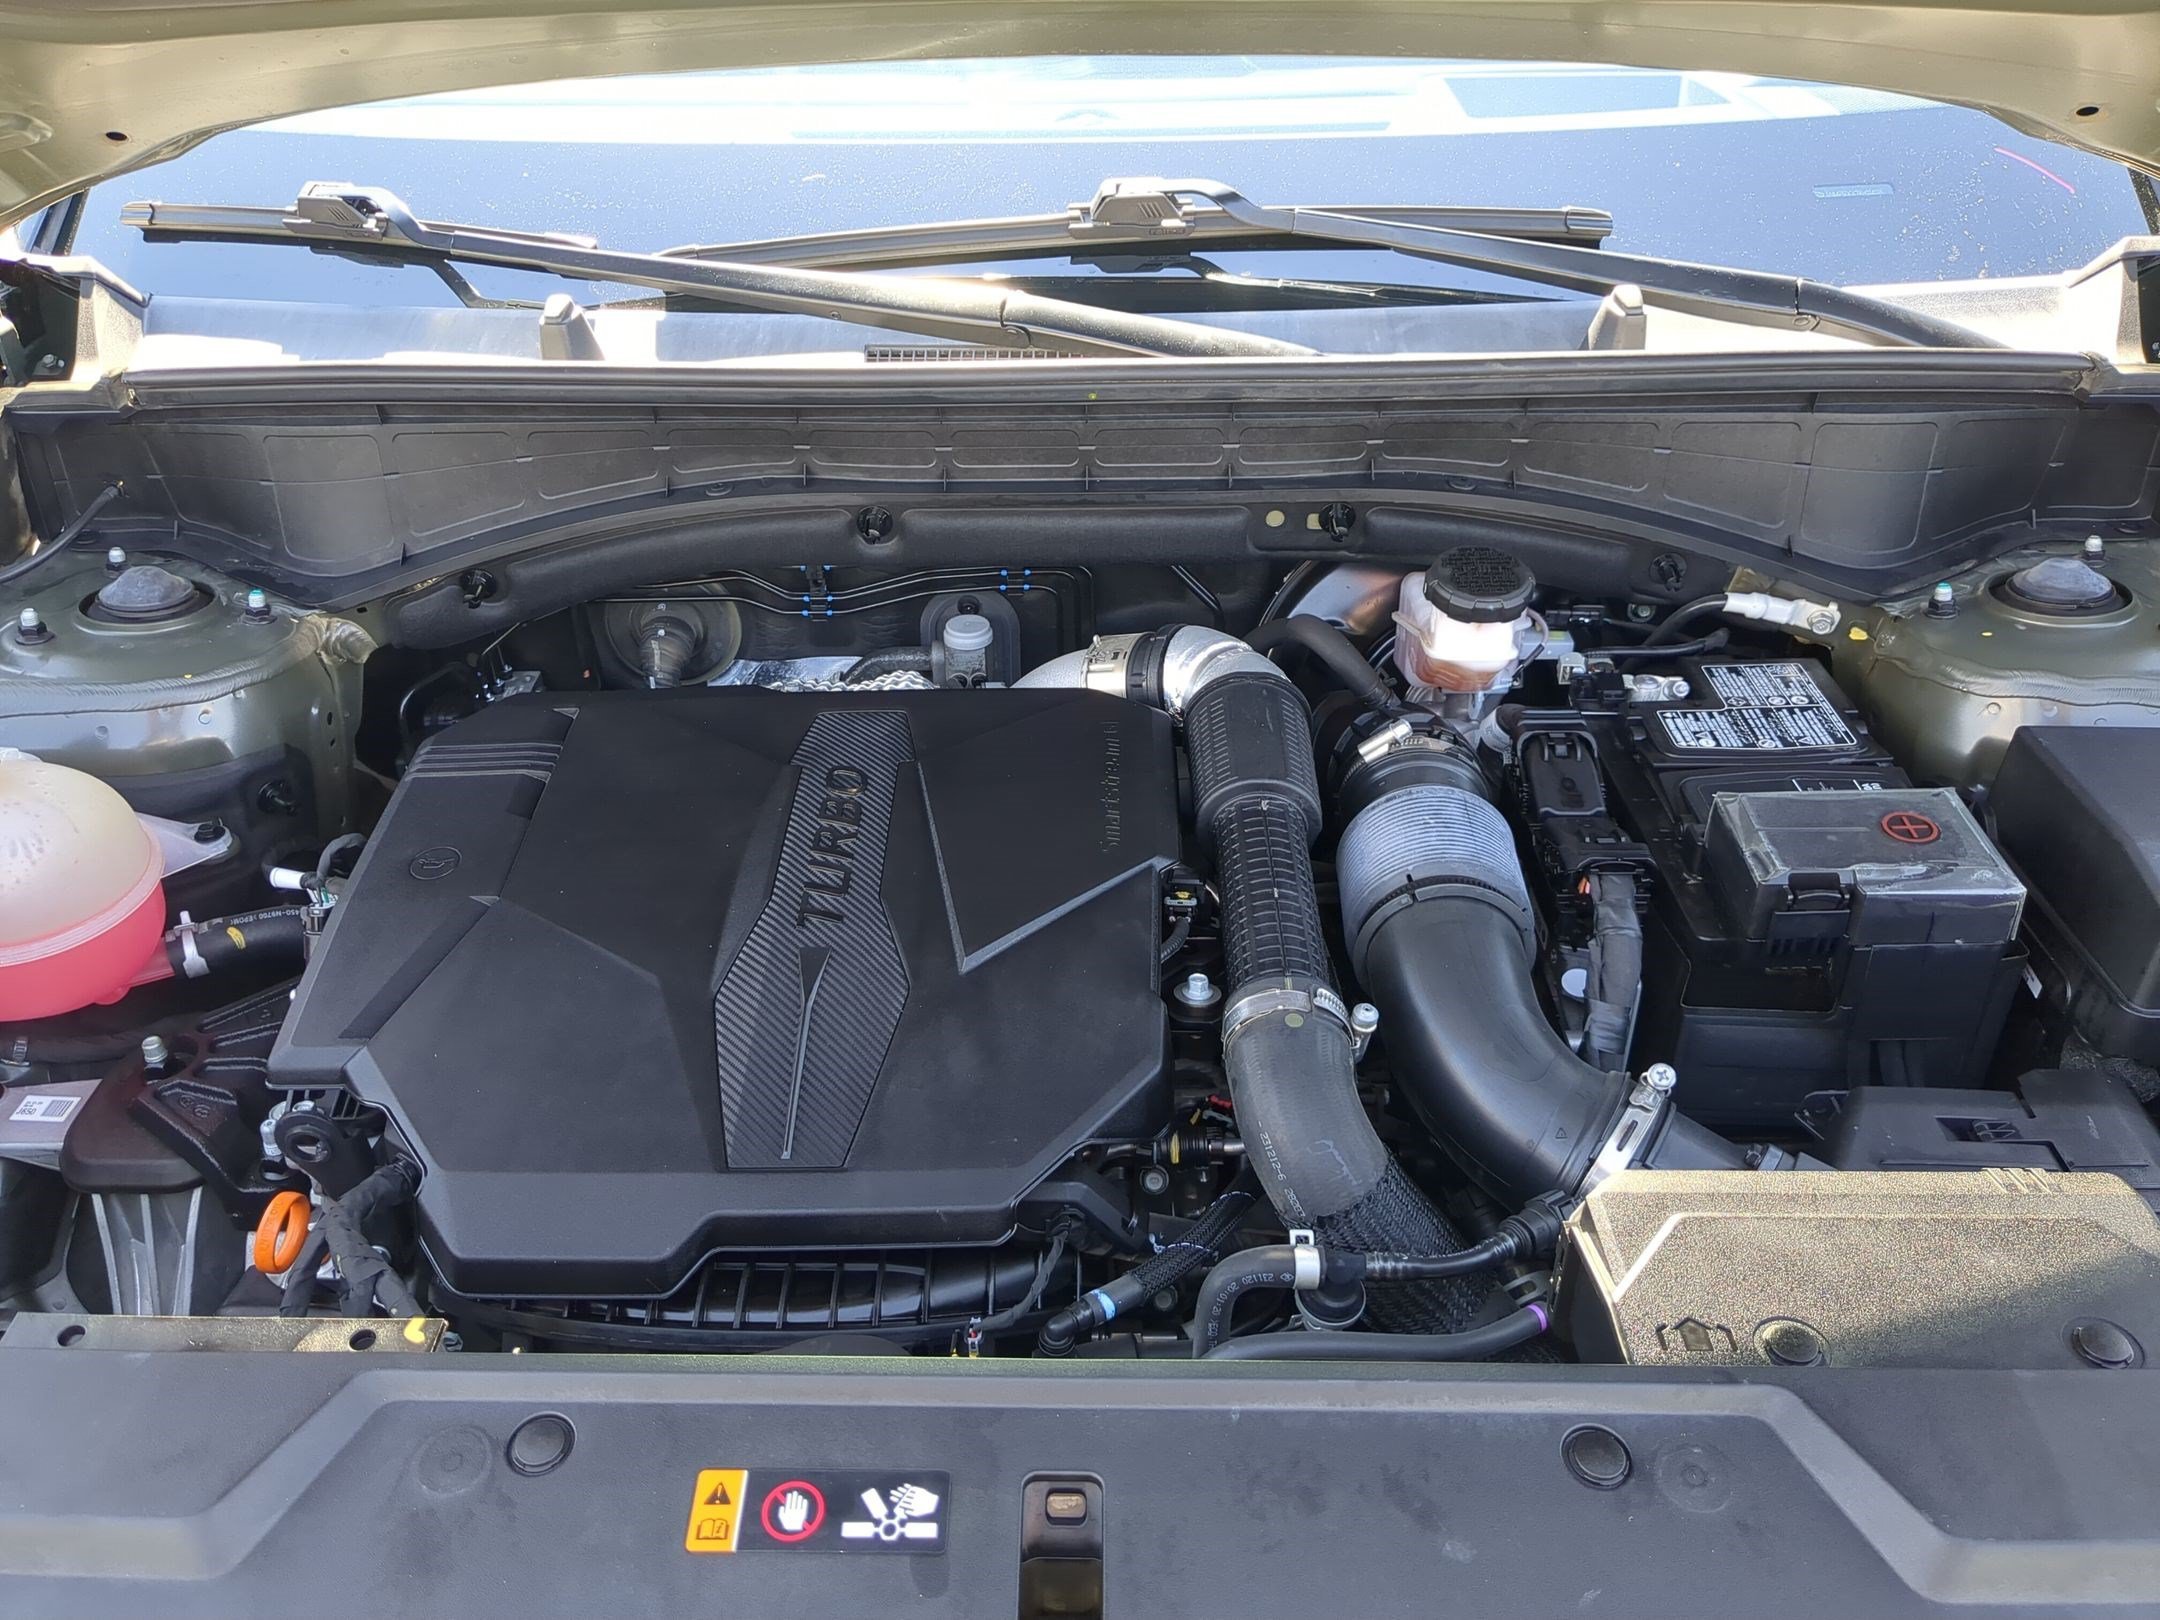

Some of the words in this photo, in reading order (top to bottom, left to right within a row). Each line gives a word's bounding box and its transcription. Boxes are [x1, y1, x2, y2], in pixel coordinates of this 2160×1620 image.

[1098, 737, 1121, 854] Smartstream
[796, 766, 867, 929] TURBO
[1260, 1131, 1287, 1181] 231212-6
[1241, 1272, 1275, 1285] 231120
